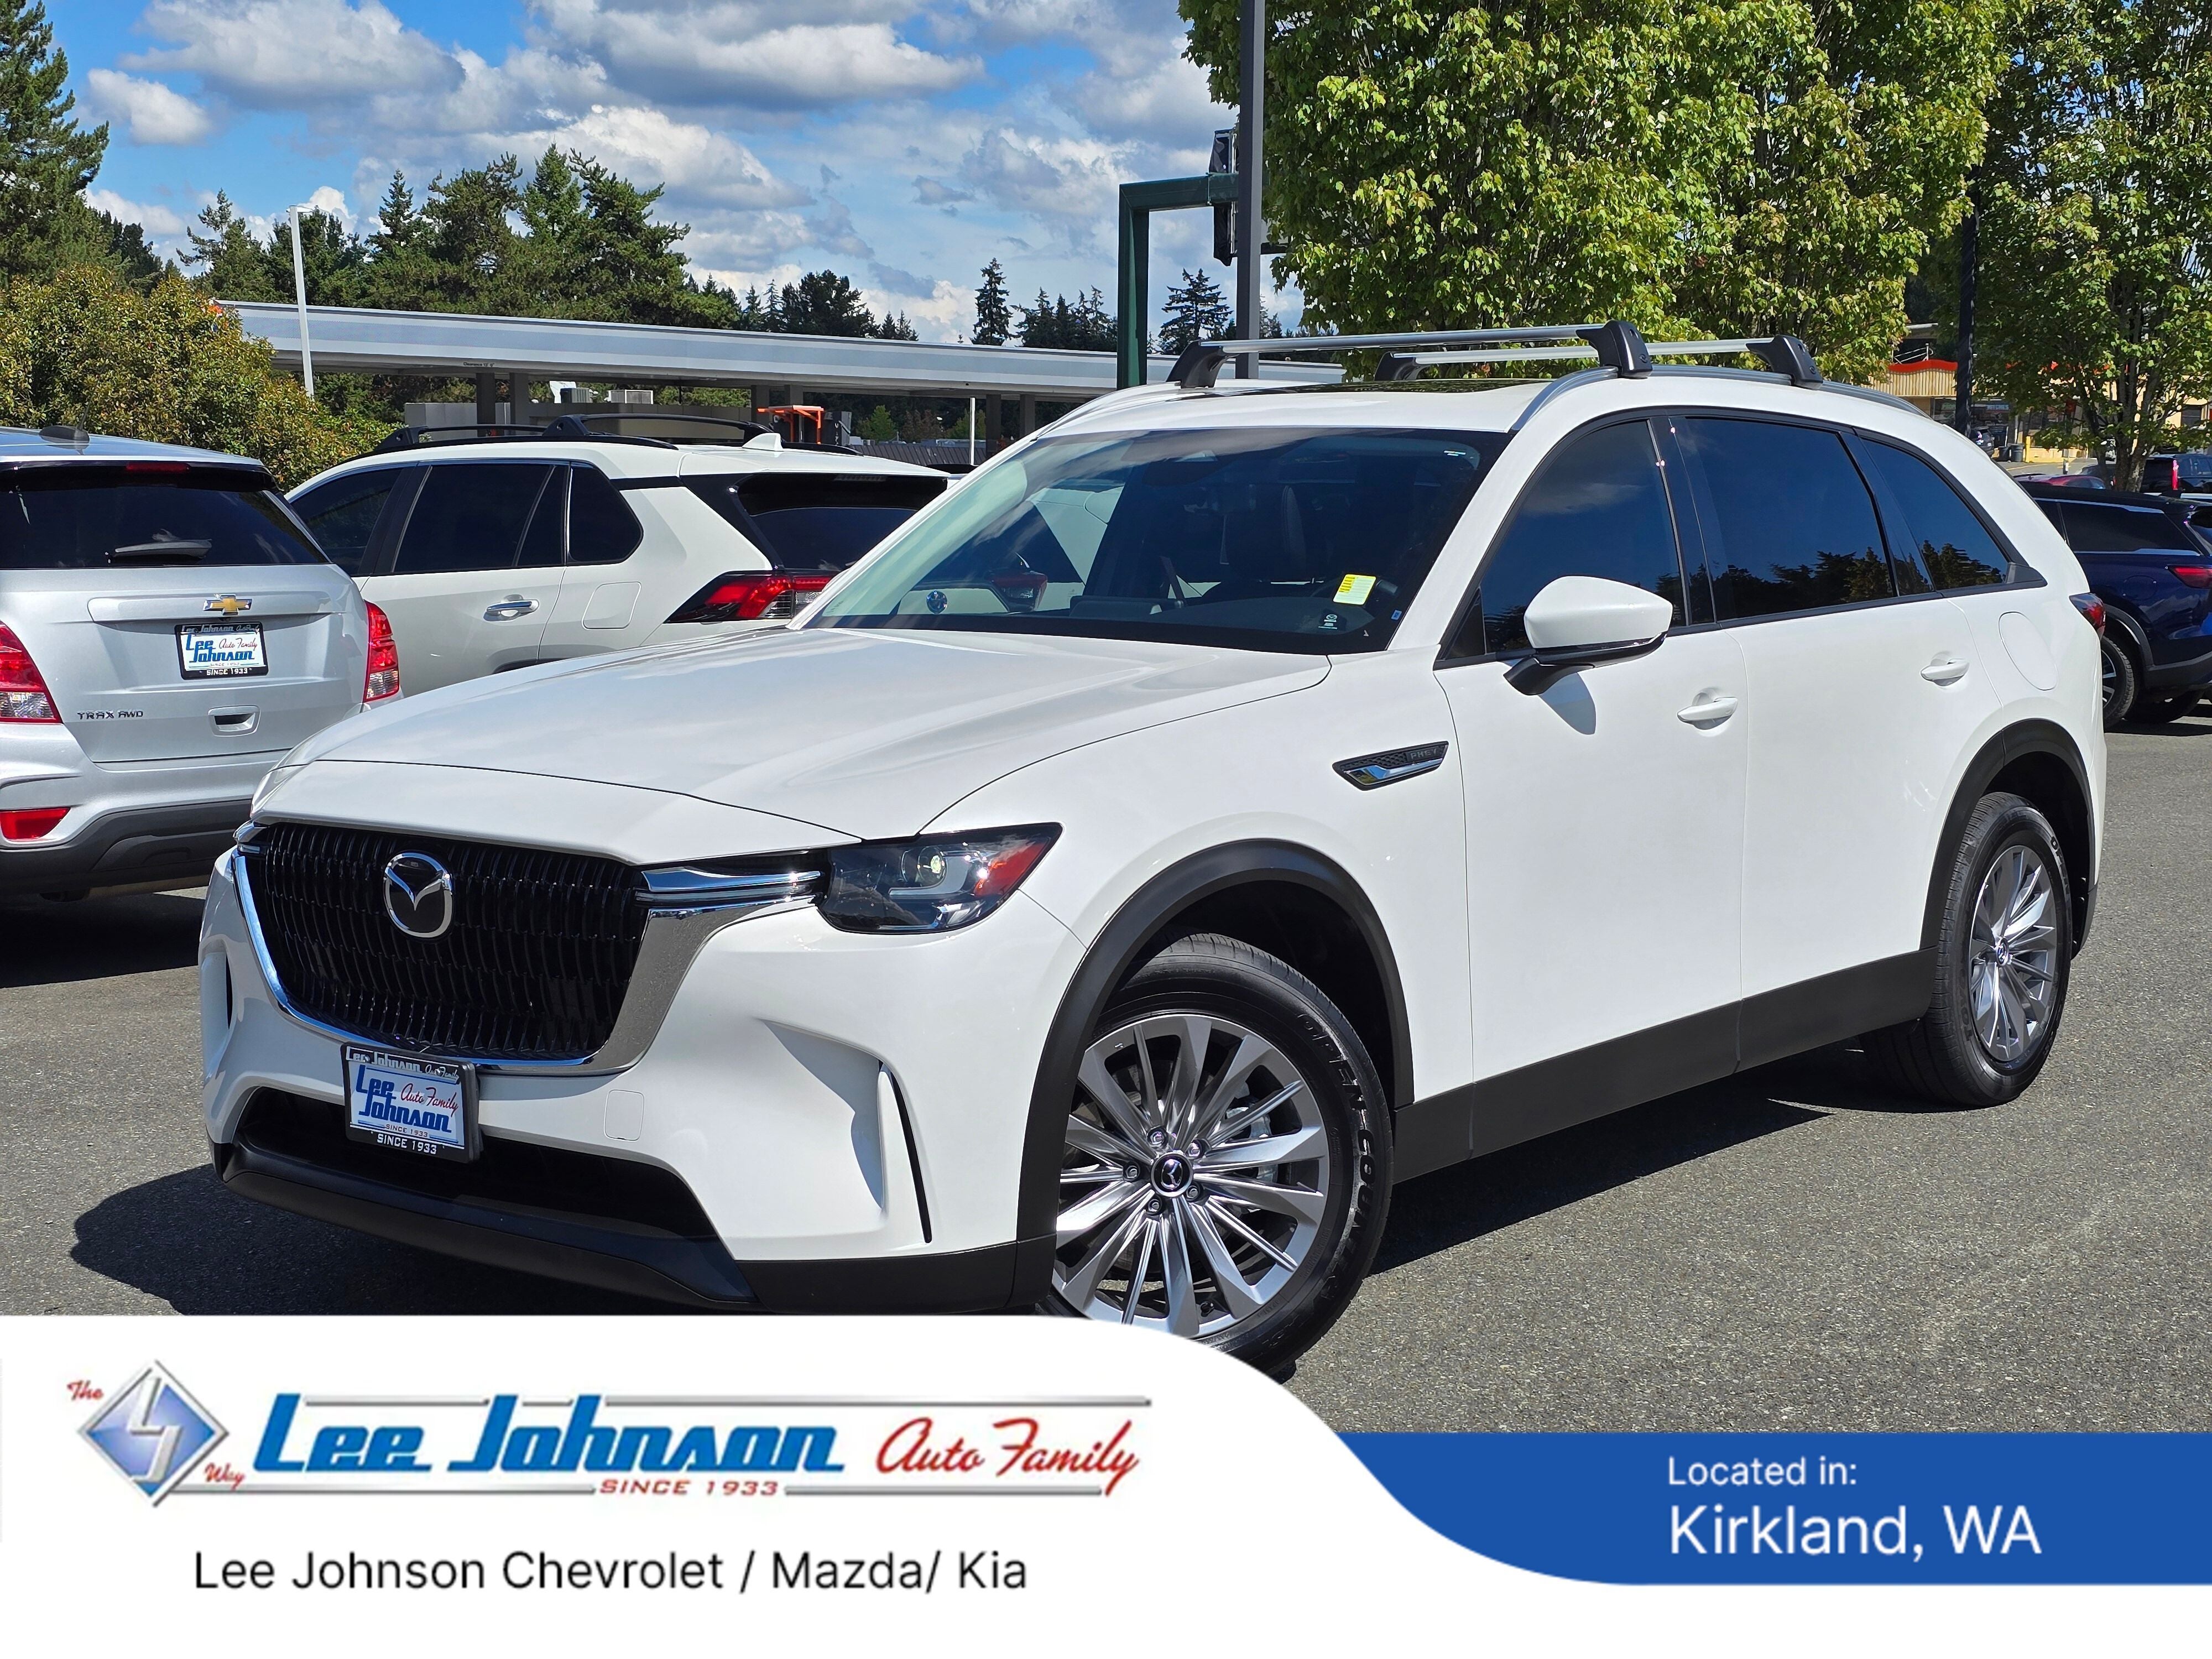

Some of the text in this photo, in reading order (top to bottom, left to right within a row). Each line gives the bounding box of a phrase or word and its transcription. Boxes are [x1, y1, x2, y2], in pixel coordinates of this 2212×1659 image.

[186, 634, 258, 651] Lee Auto Family
[189, 646, 255, 662] Johnson
[77, 710, 143, 720] TRAX AWD
[371, 1051, 423, 1073] Johnson
[356, 1065, 458, 1118] Lee Auto Family
[358, 1092, 452, 1133] Johnson
[384, 1124, 428, 1138] SINCE 1933
[377, 1134, 437, 1155] SINCE 1933
